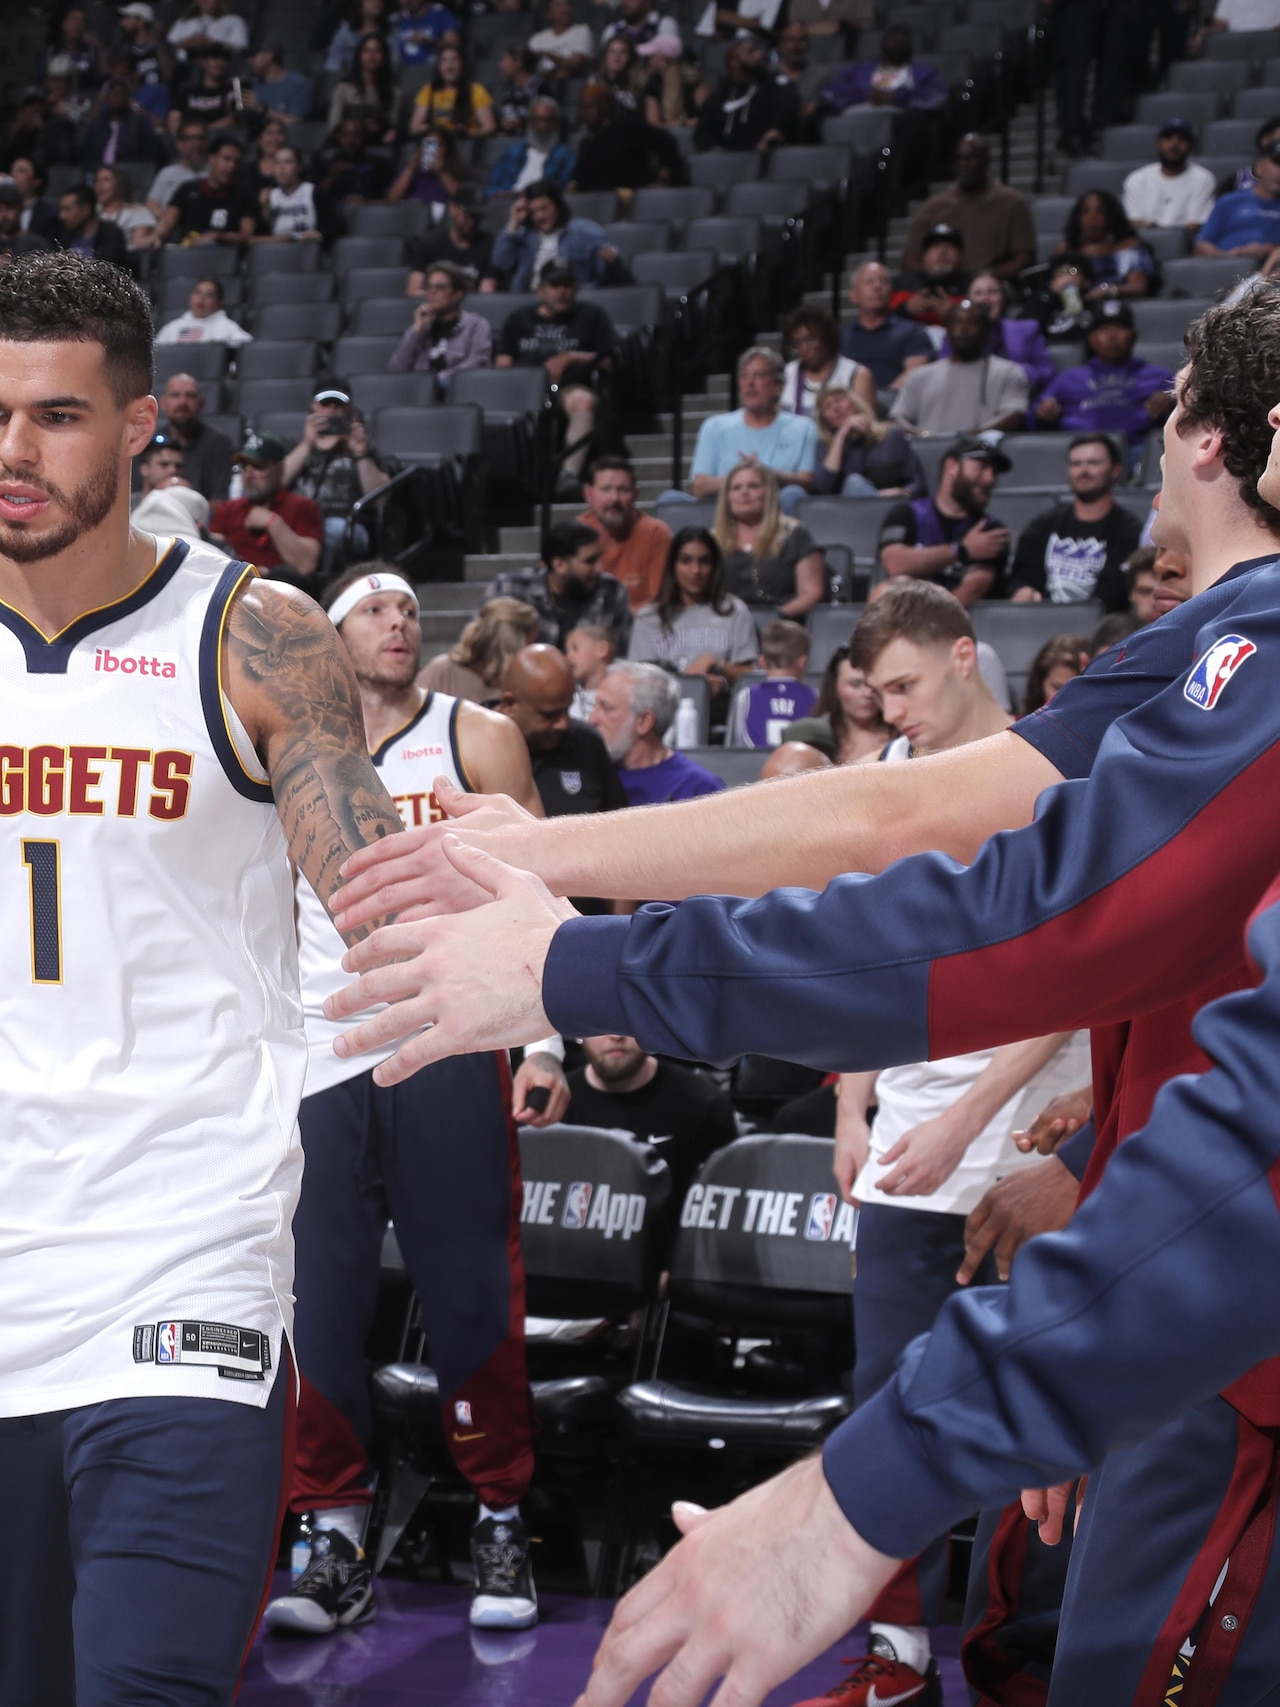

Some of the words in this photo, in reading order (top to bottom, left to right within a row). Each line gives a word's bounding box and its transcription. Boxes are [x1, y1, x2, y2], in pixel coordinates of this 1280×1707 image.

[95, 648, 176, 678] ibotta
[1187, 681, 1206, 702] NBA
[402, 746, 443, 760] ibotta
[20, 838, 63, 985] 1
[520, 1181, 561, 1224] HE
[586, 1184, 647, 1240] App
[680, 1183, 741, 1230] GET
[743, 1188, 804, 1237] THE
[185, 1333, 196, 1341] 50
